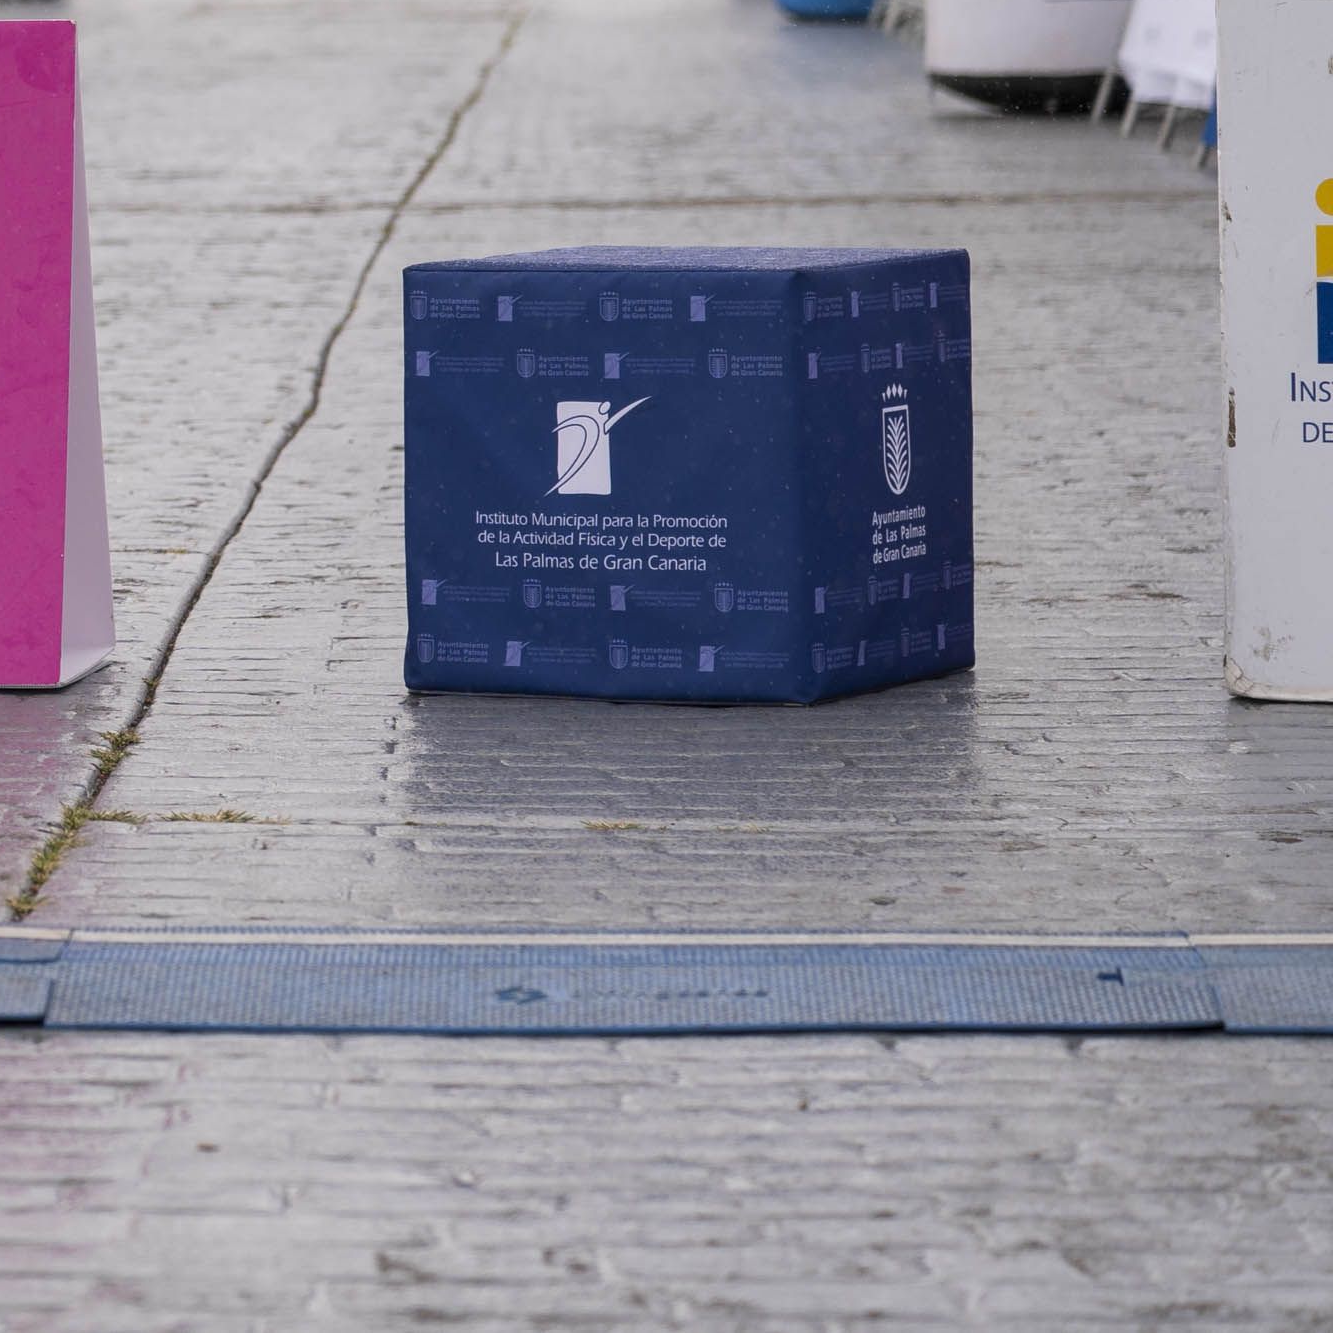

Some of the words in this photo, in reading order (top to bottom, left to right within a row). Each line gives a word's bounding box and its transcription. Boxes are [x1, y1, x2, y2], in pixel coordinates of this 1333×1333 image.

[476, 511, 528, 525] Instituto
[532, 513, 598, 530] Municipal
[603, 515, 633, 530] para
[637, 514, 649, 527] la
[653, 514, 727, 529] Promoción
[872, 504, 925, 529] Ayuntamiento
[478, 530, 495, 543] de
[499, 530, 510, 543] la
[513, 531, 573, 545] Actividad
[578, 531, 616, 546] Física
[619, 535, 628, 550] y
[632, 533, 644, 546] el
[648, 533, 704, 550] Deporte
[708, 534, 726, 548] de
[872, 529, 883, 545] de
[885, 528, 897, 543] Las
[901, 523, 926, 540] Palmas
[496, 552, 518, 567] Las
[523, 553, 574, 568] Palmas
[579, 554, 598, 570] de
[603, 554, 643, 570] Gran
[648, 555, 707, 571] Canaria
[872, 548, 882, 564] de
[883, 547, 900, 562] Gran
[901, 540, 926, 559] Canaria
